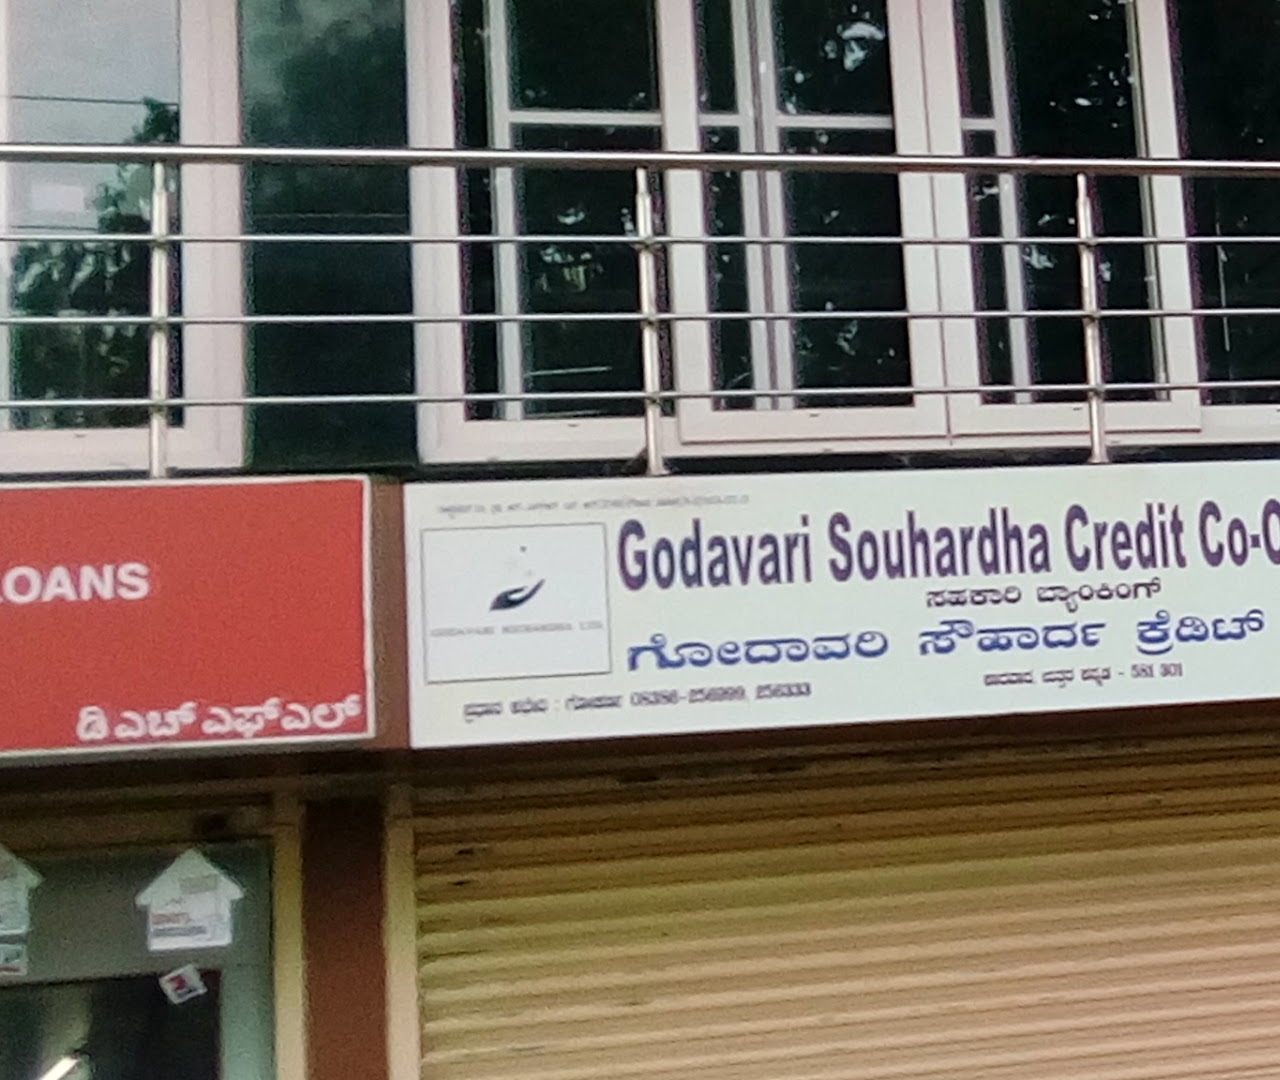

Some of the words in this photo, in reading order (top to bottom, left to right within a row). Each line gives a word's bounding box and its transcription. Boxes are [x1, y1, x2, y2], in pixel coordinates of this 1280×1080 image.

[617, 514, 812, 592] Godavari
[828, 507, 1051, 584] Souhardha
[1065, 502, 1187, 573] Credit
[0, 561, 151, 605] OANS
[926, 583, 1023, 610] ಸಹಕಾರಿ
[627, 625, 889, 672] ಗೋದಾವರಿ
[918, 618, 1106, 658] ಸೌಹಾರ್ದ
[1135, 608, 1265, 657] ಕ್ರೆಡಿಟ್
